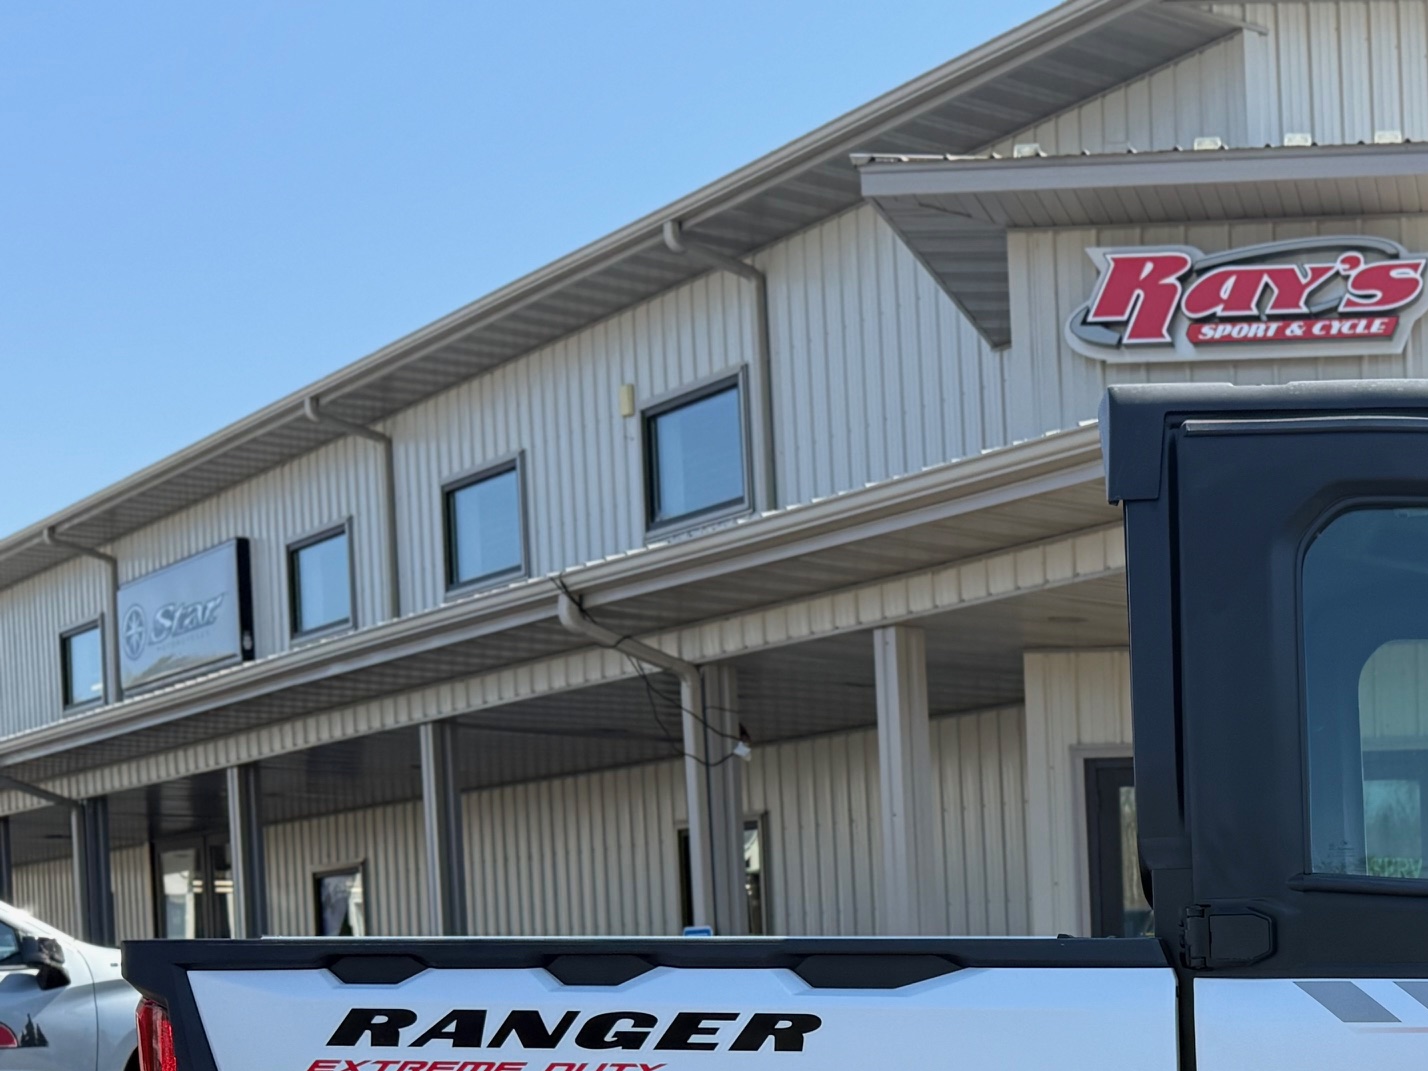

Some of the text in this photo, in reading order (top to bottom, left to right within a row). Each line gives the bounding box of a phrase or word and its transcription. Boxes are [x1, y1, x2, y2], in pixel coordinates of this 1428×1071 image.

[1198, 318, 1390, 340] SPORT & CYCLE
[325, 1007, 822, 1052] RANGER
